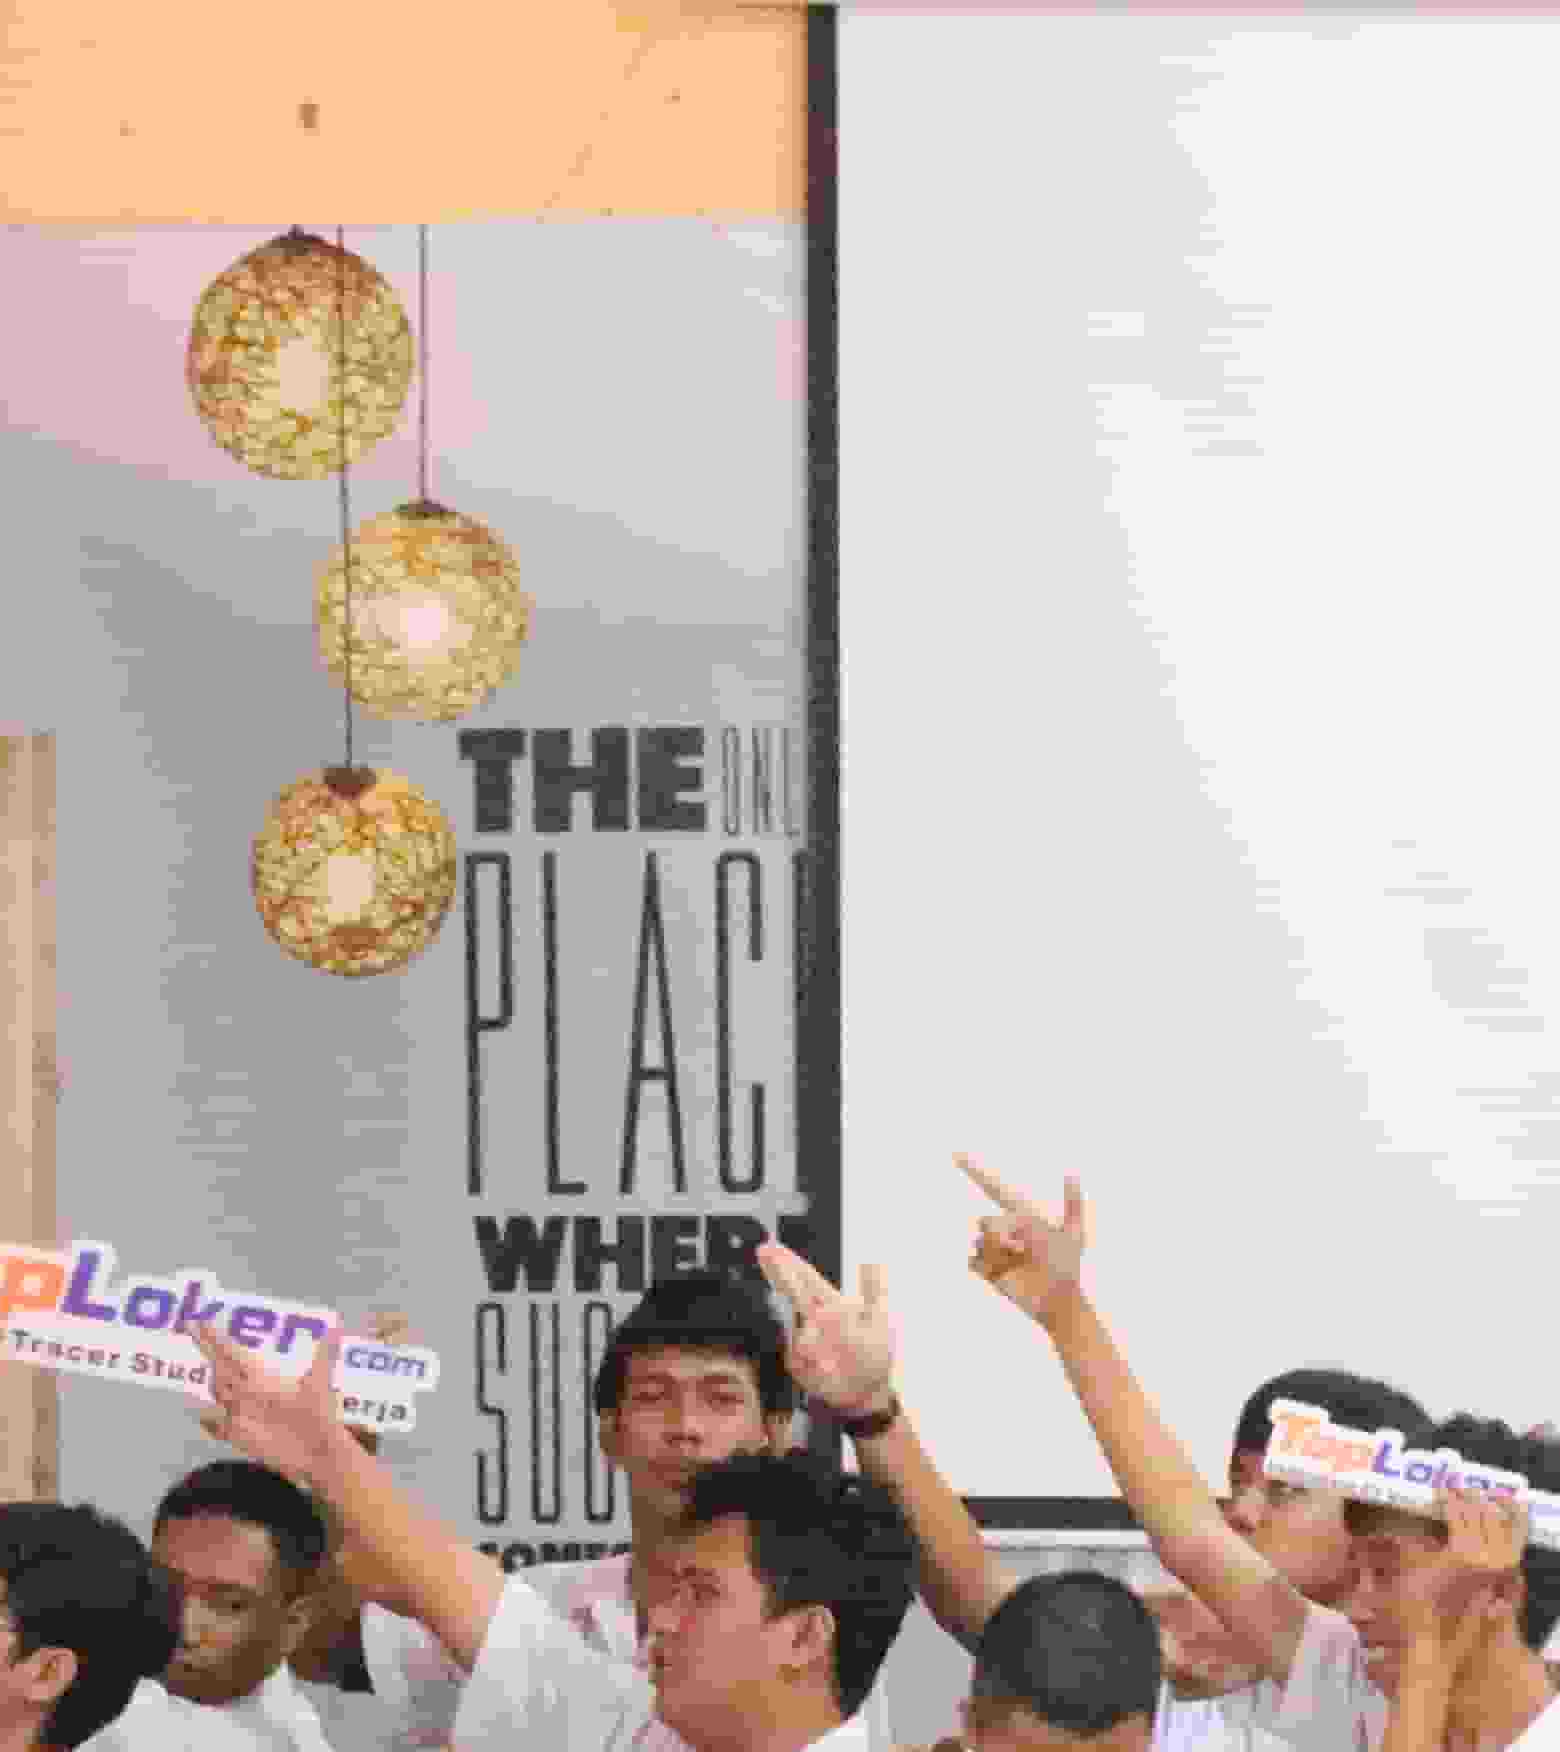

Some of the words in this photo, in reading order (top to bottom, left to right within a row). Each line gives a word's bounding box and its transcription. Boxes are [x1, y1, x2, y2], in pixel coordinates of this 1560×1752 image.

[459, 727, 708, 834] THE
[720, 727, 803, 836] ONL
[464, 851, 805, 1196] PLAC
